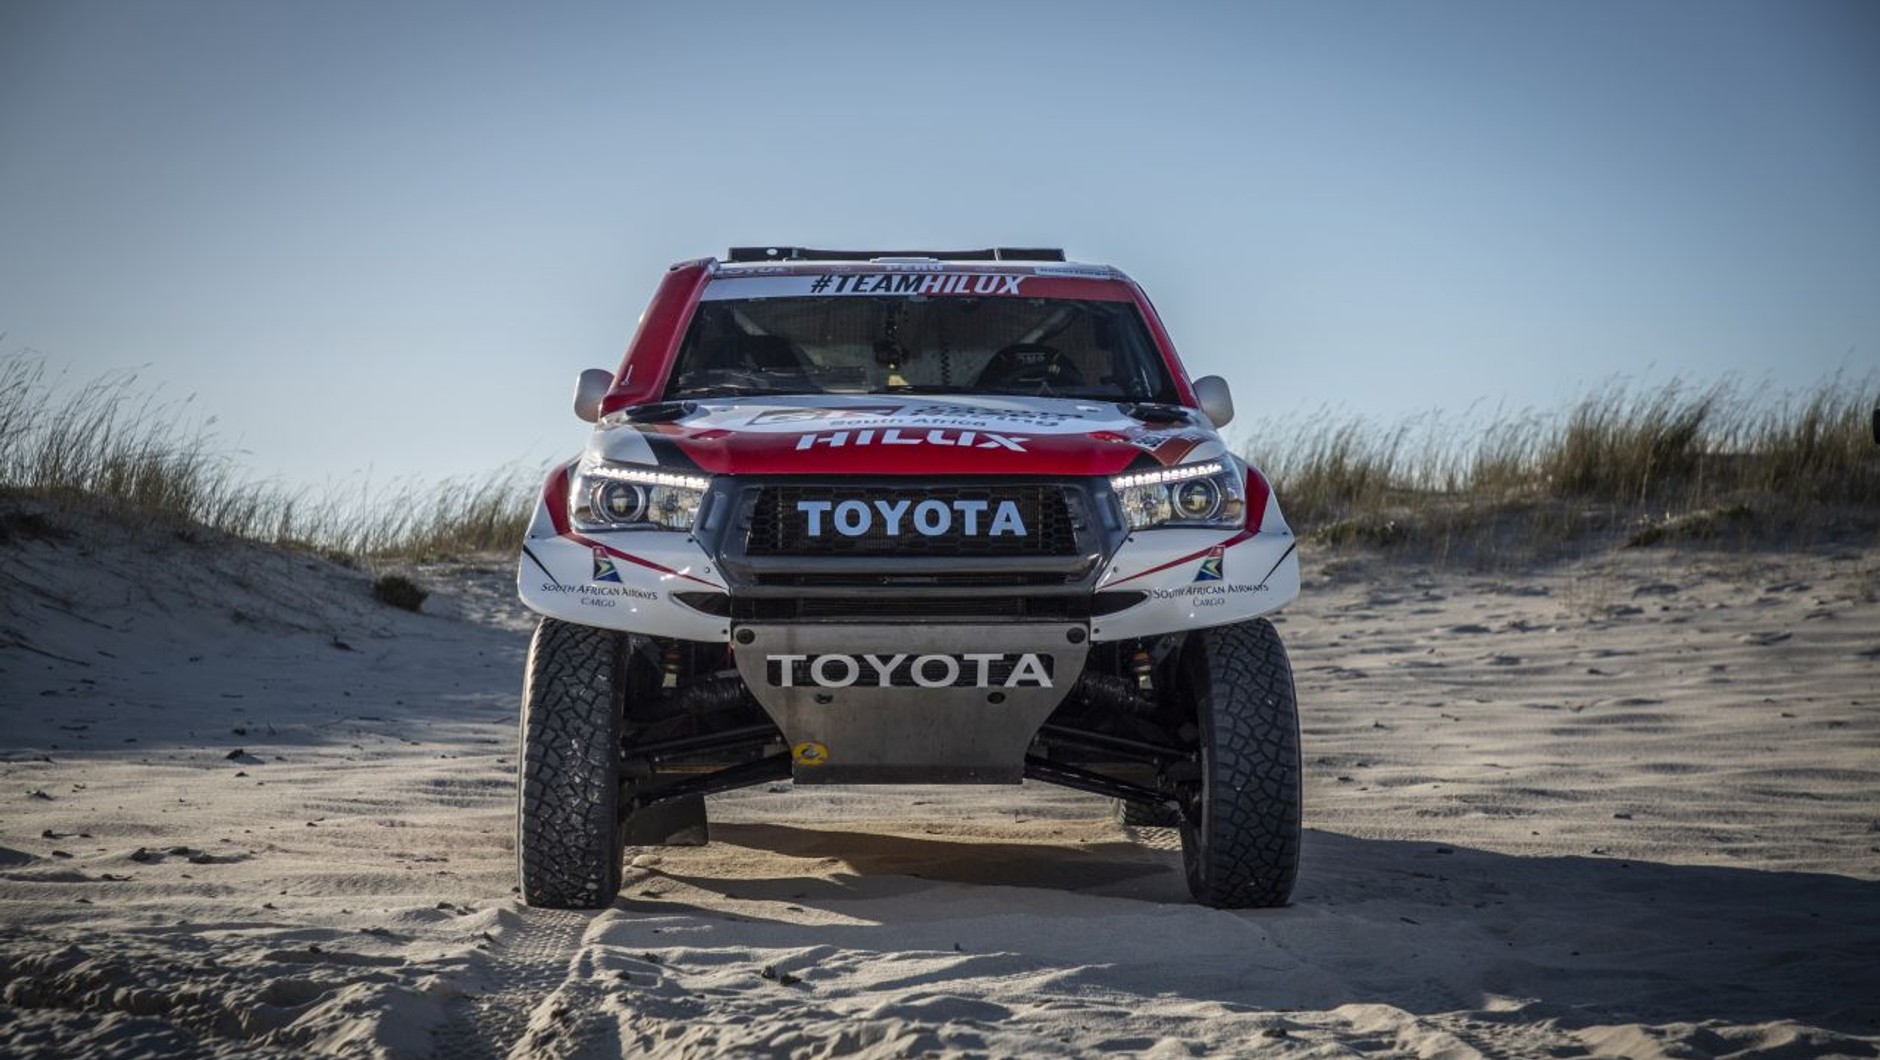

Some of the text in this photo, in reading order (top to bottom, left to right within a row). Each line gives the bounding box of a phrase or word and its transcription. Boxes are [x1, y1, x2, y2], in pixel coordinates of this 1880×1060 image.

[810, 274, 1025, 294] #TEAMHILUX
[796, 429, 1031, 452] HILUX
[797, 500, 1028, 537] TOYOTA
[576, 584, 620, 597] AFRICAN
[1185, 585, 1225, 596] AFRICAN
[580, 598, 616, 608] CARGO
[1192, 597, 1225, 607] CARGO
[766, 653, 1054, 688] TOYOTA
